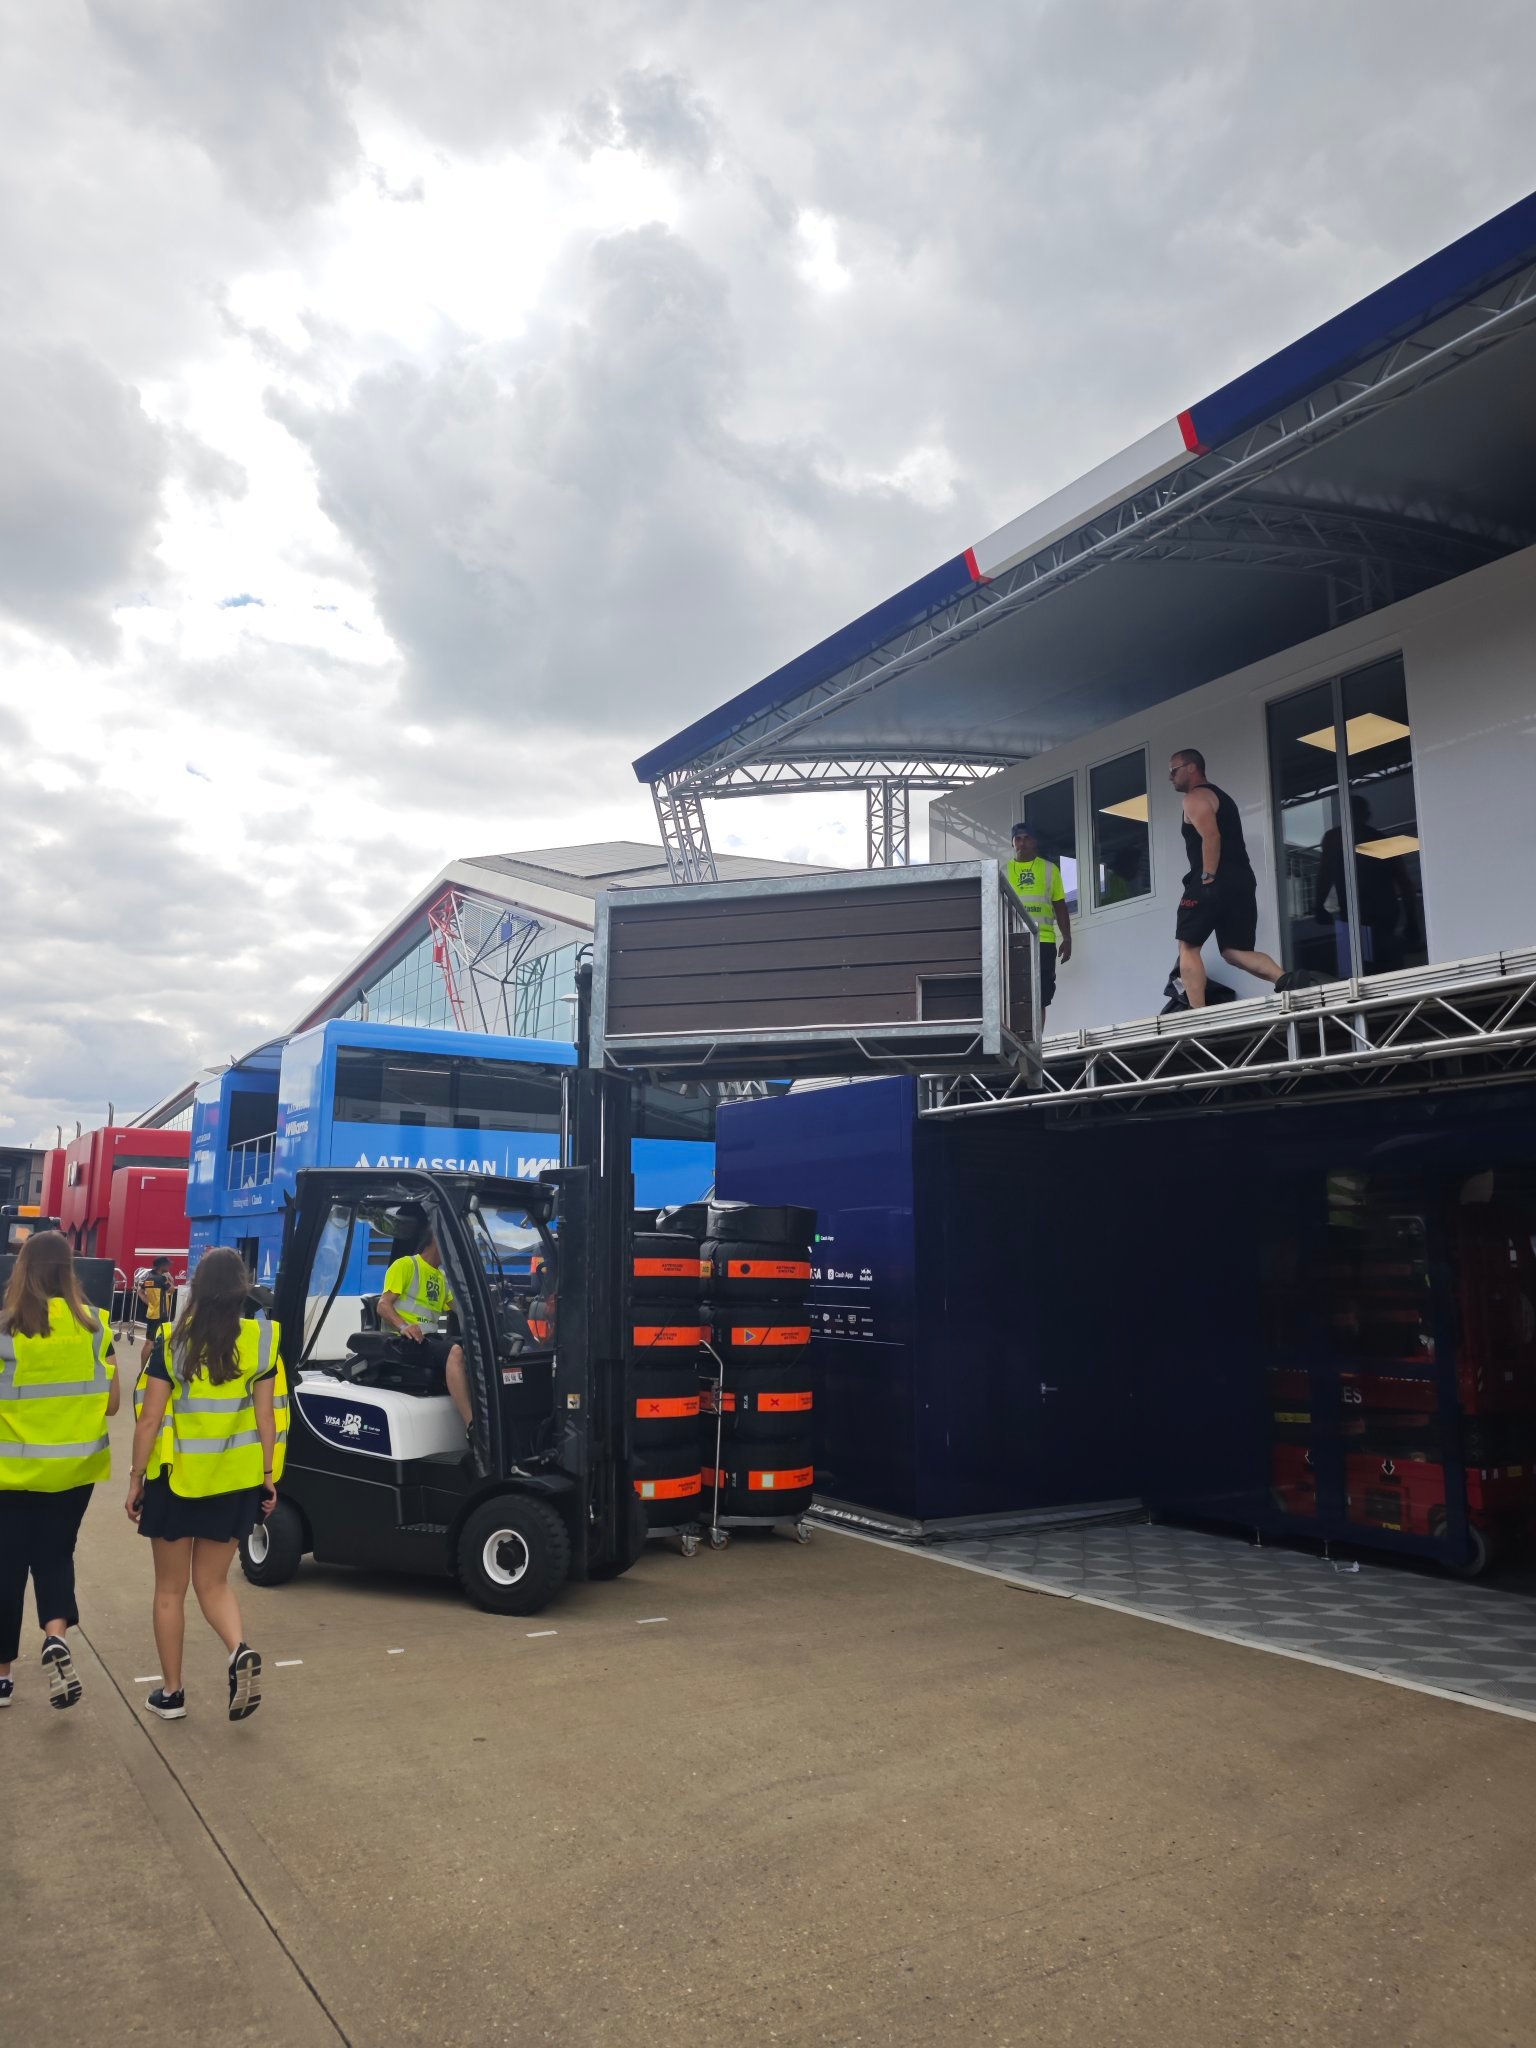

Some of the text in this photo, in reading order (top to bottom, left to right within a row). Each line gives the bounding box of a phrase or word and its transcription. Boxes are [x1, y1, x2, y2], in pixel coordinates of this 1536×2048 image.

[376, 1155, 497, 1176] ATLASSIAN
[844, 1271, 854, 1280] App
[324, 1415, 341, 1426] VISA
